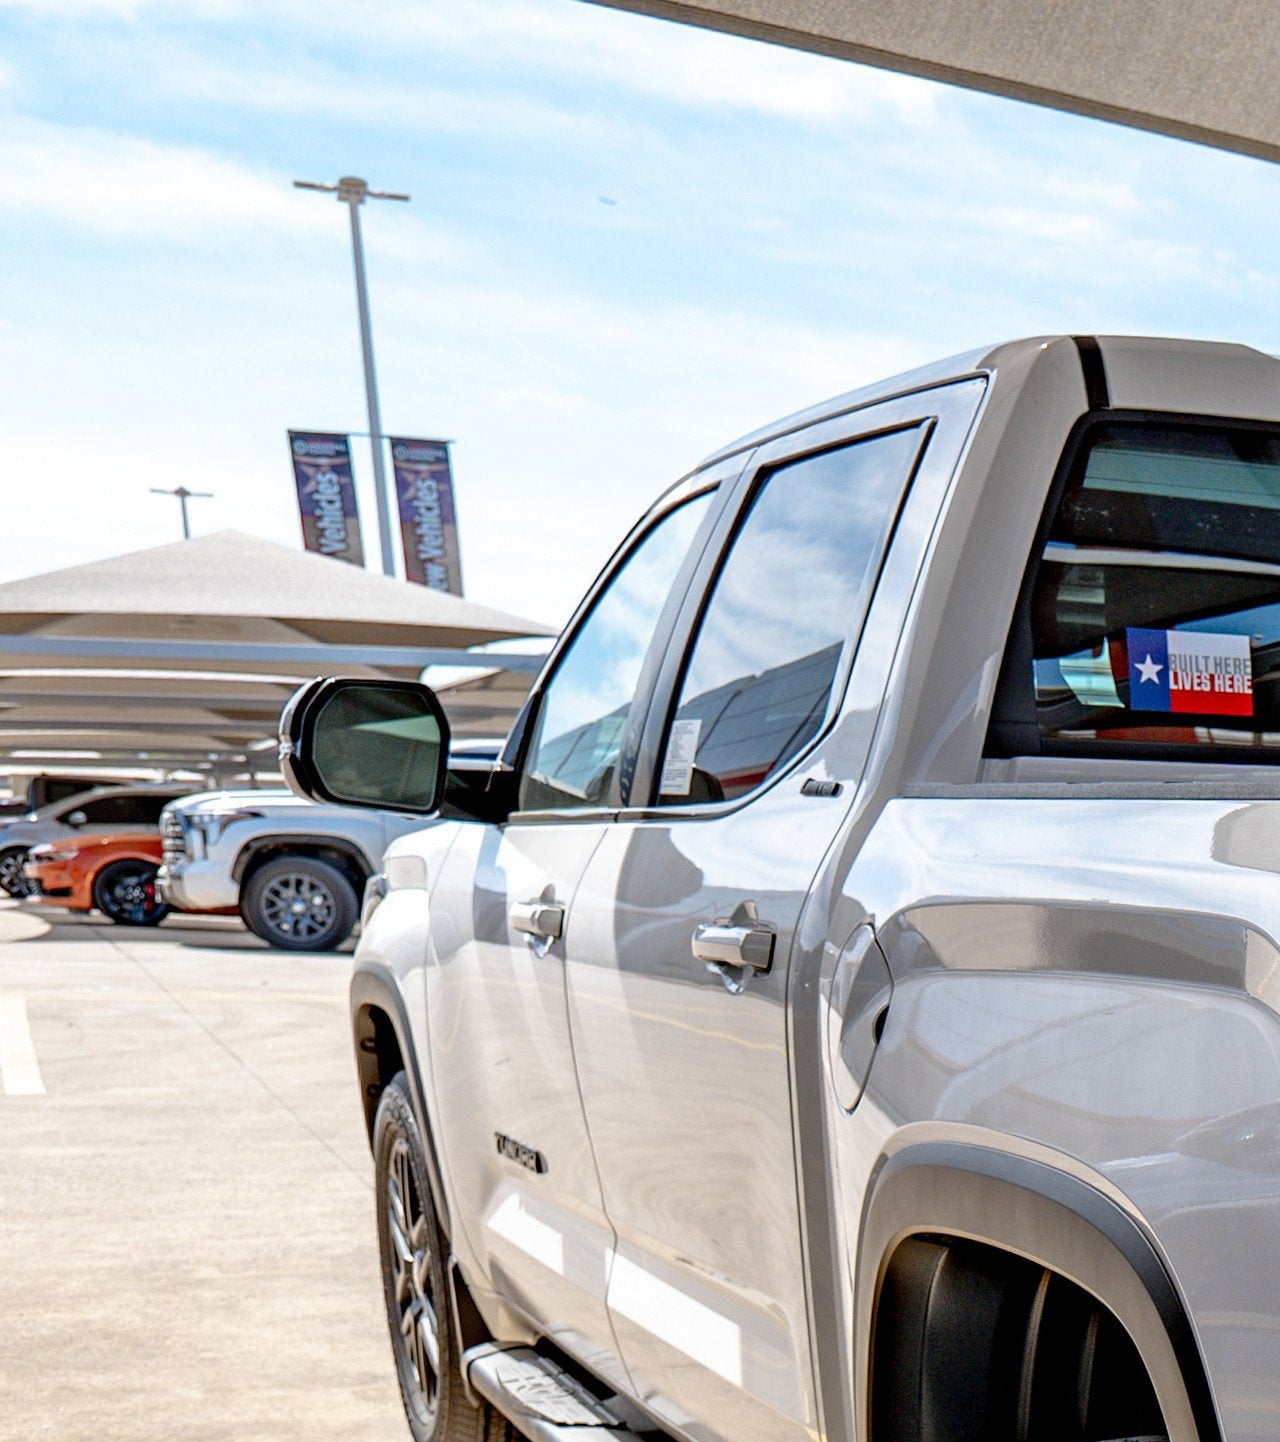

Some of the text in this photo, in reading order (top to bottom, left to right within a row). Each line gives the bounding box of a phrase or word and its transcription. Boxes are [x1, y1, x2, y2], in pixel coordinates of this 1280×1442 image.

[312, 470, 348, 553] Vehicles
[412, 478, 447, 560] Vehicles
[425, 562, 449, 592] ew
[1168, 653, 1252, 675] BUILT HERE
[1169, 671, 1253, 694] LIVES HERE
